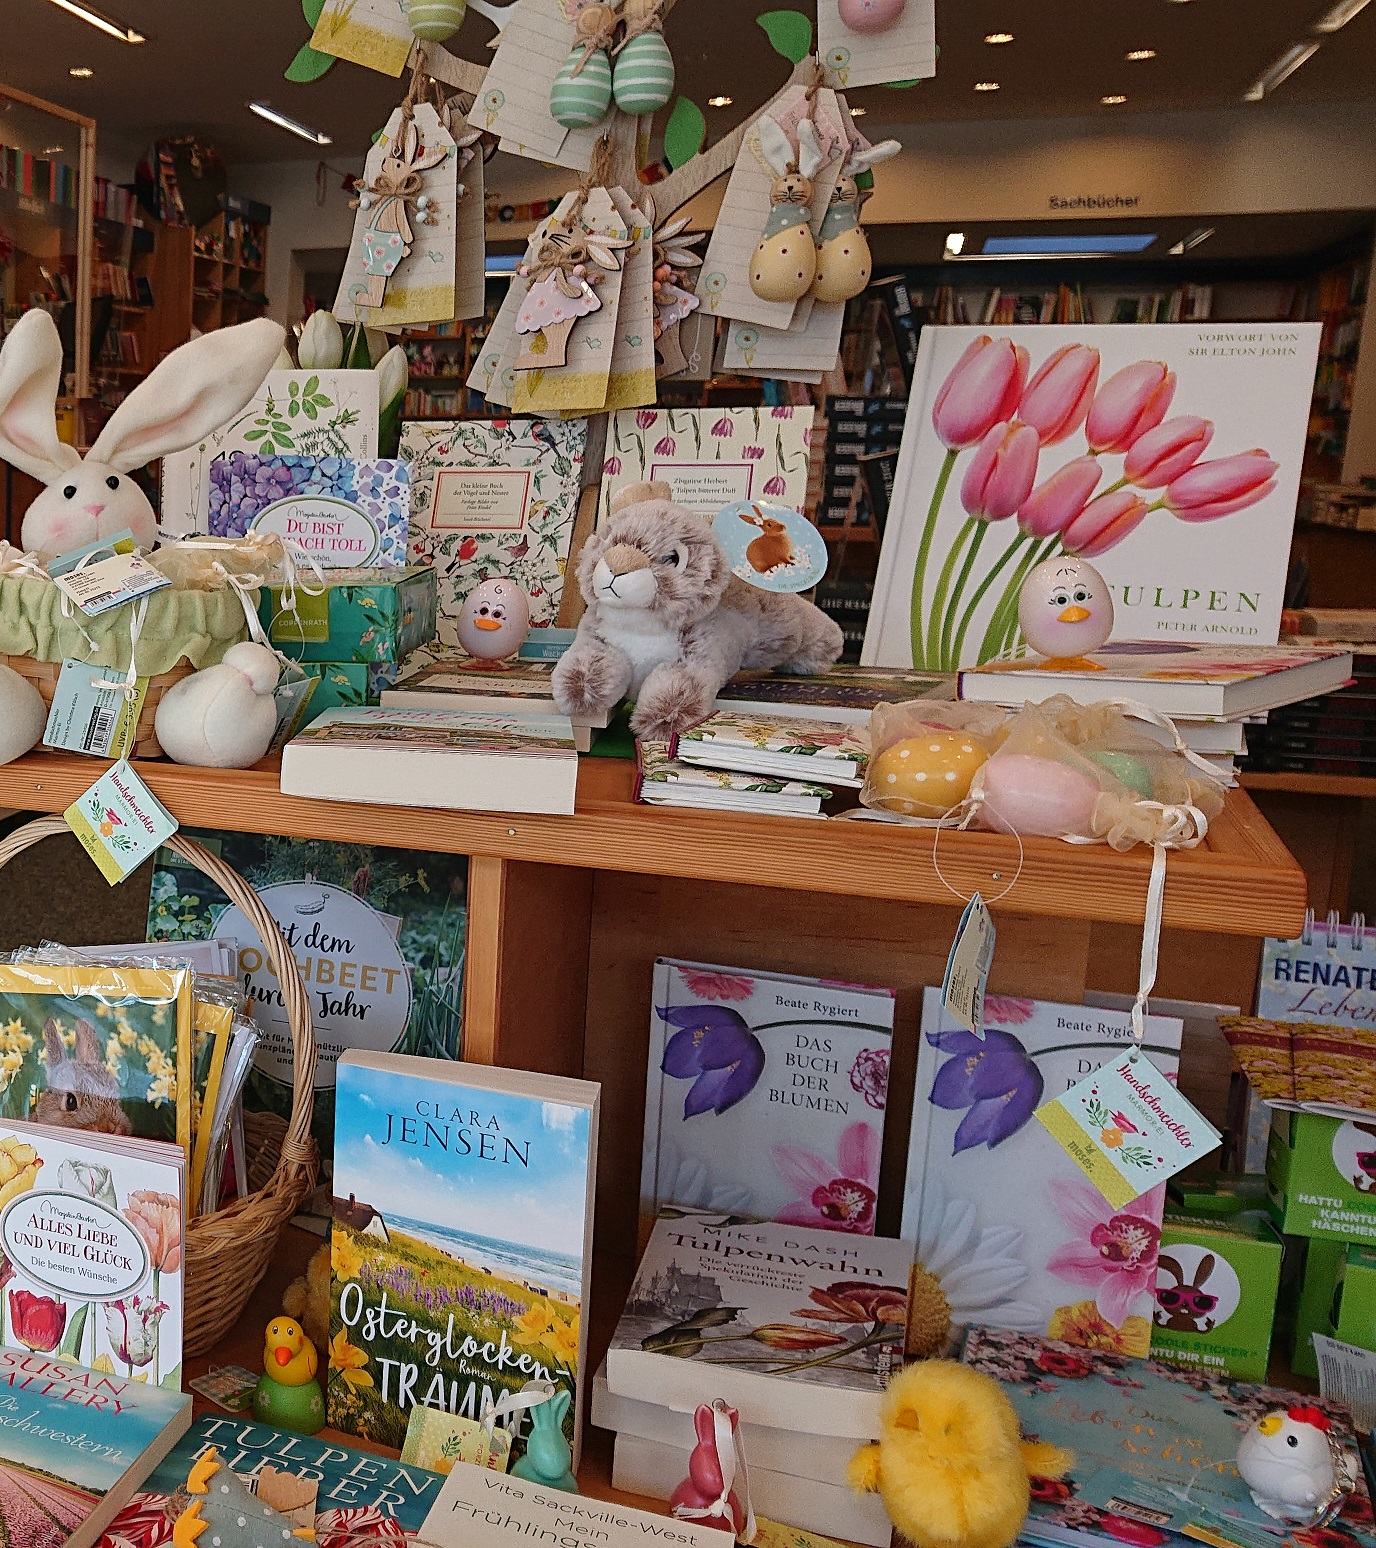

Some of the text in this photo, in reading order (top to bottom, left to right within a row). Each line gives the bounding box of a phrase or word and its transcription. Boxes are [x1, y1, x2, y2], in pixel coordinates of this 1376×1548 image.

[1048, 194, 1141, 210] Sachbücher
[1197, 333, 1299, 341] VORWORT VON
[1188, 347, 1297, 357] SIR ELTON JOHN
[676, 487, 696, 495] Tulpen
[286, 518, 345, 536] DU BIST
[294, 552, 308, 560] Wie
[329, 538, 367, 552] TOLL
[1108, 584, 1261, 613] ULPEN
[1156, 620, 1259, 636] PETER ARNOLD
[109, 771, 156, 835] Handschmeichler
[80, 833, 96, 857] moses.
[304, 922, 356, 955] dem
[238, 947, 402, 996] OHBEET
[1274, 957, 1376, 990] RENAT
[315, 990, 372, 1020] Jahr
[775, 995, 859, 1018] Beate Rygiert
[1056, 1017, 1136, 1040] Beate Rygie
[796, 1034, 833, 1053] DAS
[786, 1053, 839, 1074] BUCH
[1077, 1058, 1105, 1074] DA
[792, 1073, 830, 1093] DER
[769, 1088, 850, 1115] BLUMEN
[1116, 1062, 1195, 1149] Handschmeichler
[416, 1100, 502, 1132] CLARA
[1126, 1093, 1166, 1137] MARMOR-EI
[381, 1113, 532, 1168] JENSEN
[1066, 1139, 1094, 1174] moses.
[1298, 1194, 1343, 1209] HATTU
[26, 1212, 118, 1248] ALLES LIEBE
[702, 1226, 859, 1258] MIKE DASH
[13, 1231, 134, 1272] UND VIEL GLÜCK
[667, 1233, 884, 1278] Tulpenwahn
[30, 1255, 118, 1285] Die besten Wünsche
[699, 1256, 807, 1279] Die verrückteste
[699, 1263, 804, 1285] Spekulation der
[728, 1275, 804, 1292] Geschichte
[339, 1282, 570, 1384] Osterglocken-
[1150, 1347, 1225, 1367] NTU DIR EIN
[1194, 1341, 1249, 1358] STICKER
[459, 1358, 497, 1382] Roman
[375, 1356, 531, 1441] TRÄUM
[202, 1416, 438, 1496] TULPEN
[484, 1477, 698, 1547] Vita Sackville-West
[554, 1517, 609, 1542] Mein
